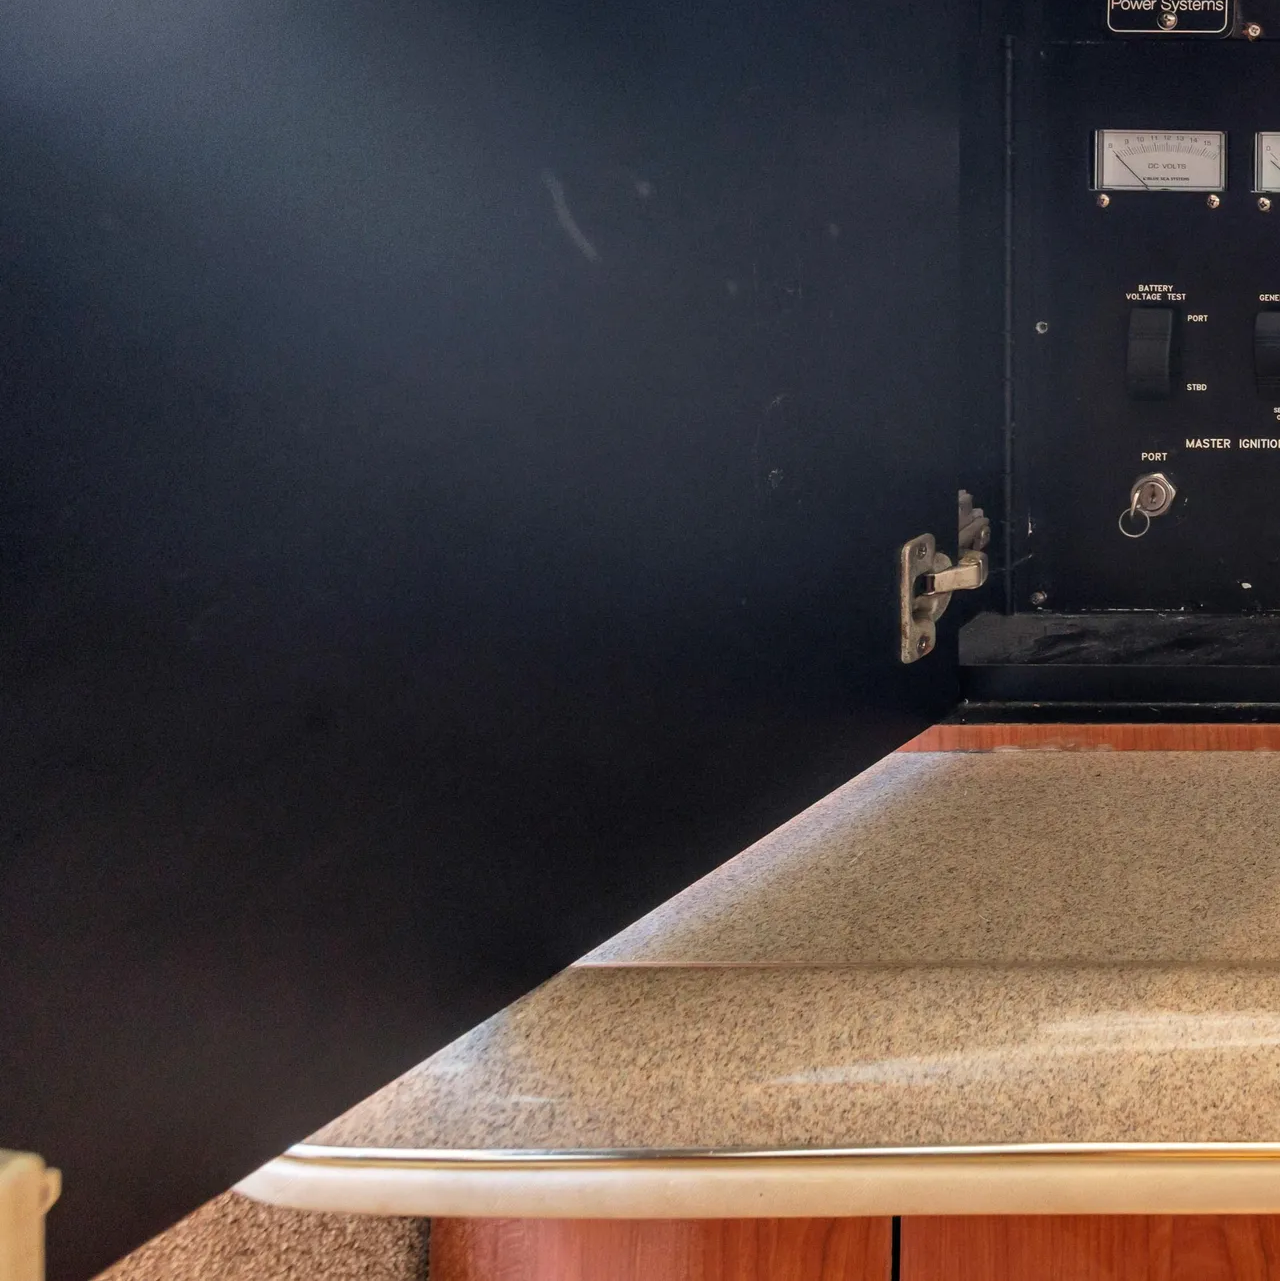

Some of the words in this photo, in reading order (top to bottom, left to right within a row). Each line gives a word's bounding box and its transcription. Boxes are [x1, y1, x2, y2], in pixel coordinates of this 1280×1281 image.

[1146, 162, 1161, 171] DC
[1161, 162, 1188, 171] VOLTS
[1138, 284, 1174, 293] BATTERY
[1125, 292, 1162, 301] VOLTAGE
[1166, 292, 1187, 301] TEST
[1187, 314, 1209, 322] PORT
[1186, 383, 1208, 391] STBD
[1185, 438, 1231, 449] MASTER
[1141, 452, 1168, 462] PORT
